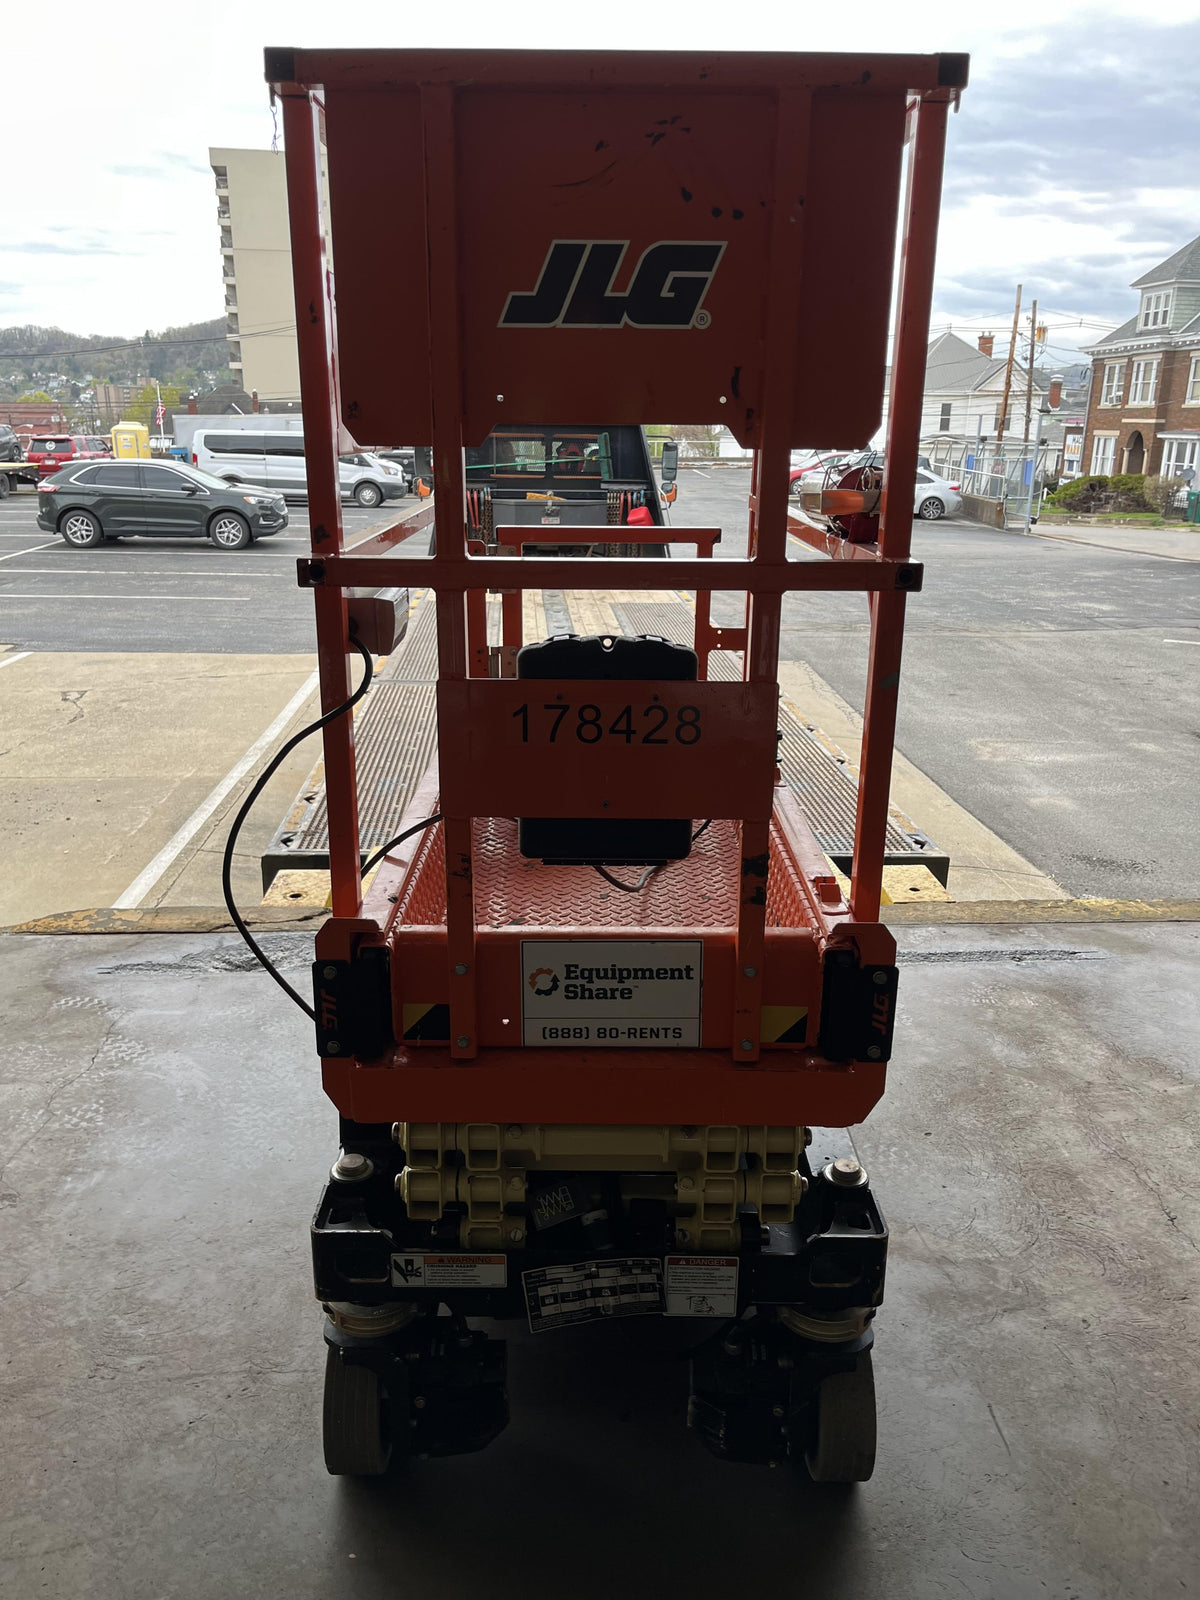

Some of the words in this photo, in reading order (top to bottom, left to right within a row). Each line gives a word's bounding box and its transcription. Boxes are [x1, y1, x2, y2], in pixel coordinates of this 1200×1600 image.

[513, 704, 701, 745] 178428
[564, 964, 694, 983] Equipment
[320, 988, 338, 1032] JLG
[872, 992, 889, 1036] JLG
[542, 1026, 590, 1040] (888)
[597, 1027, 682, 1039] 80-RENTS
[447, 1256, 496, 1264] WARNING
